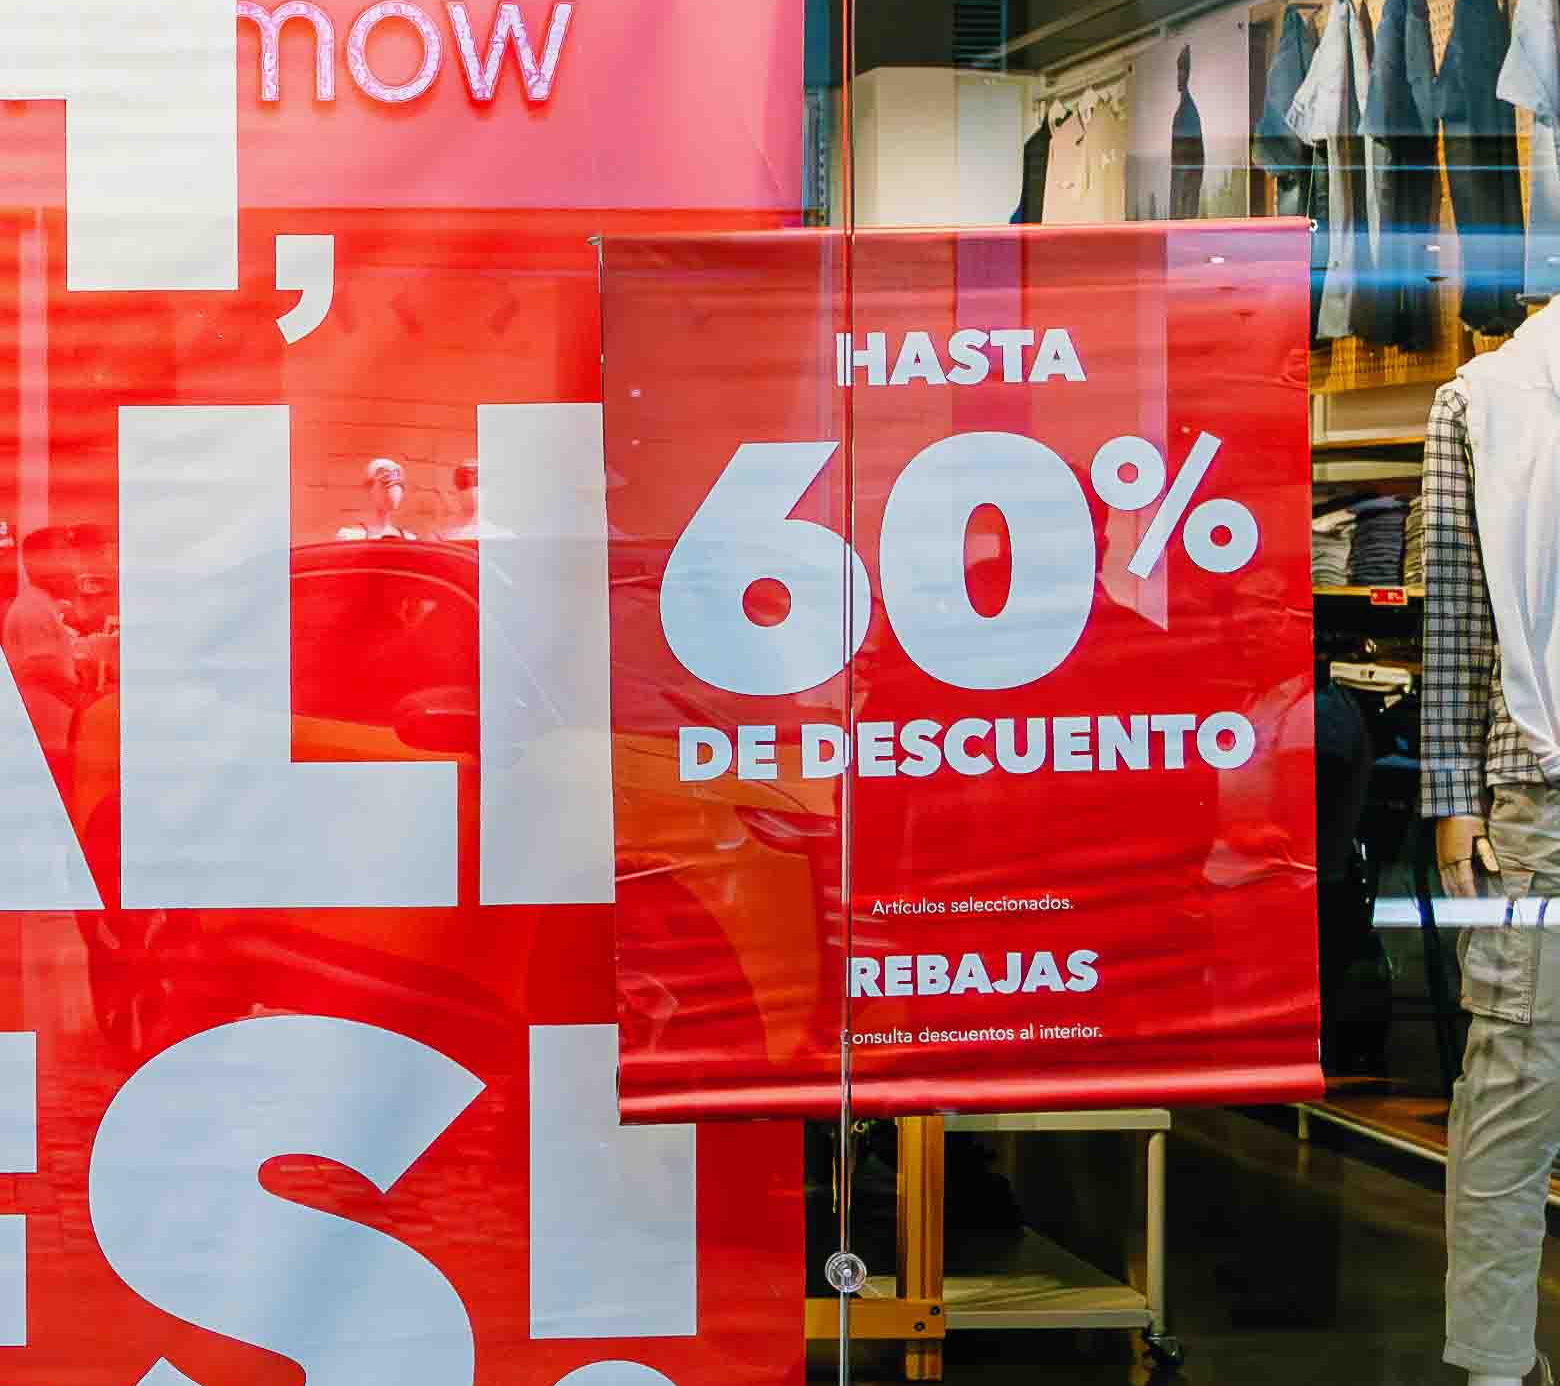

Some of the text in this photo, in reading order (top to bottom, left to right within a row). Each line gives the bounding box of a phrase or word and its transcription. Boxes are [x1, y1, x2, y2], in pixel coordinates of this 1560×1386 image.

[837, 328, 1086, 387] HASTA
[658, 430, 1260, 696] 60%
[678, 710, 1256, 783] DE DESCUENTO
[872, 894, 1074, 916] Artículos seleccionados.
[845, 949, 1100, 998] REBAJAS
[917, 1025, 1015, 1044] descuentos
[1019, 1023, 1035, 1041] al
[1039, 1023, 1104, 1040] interior.
